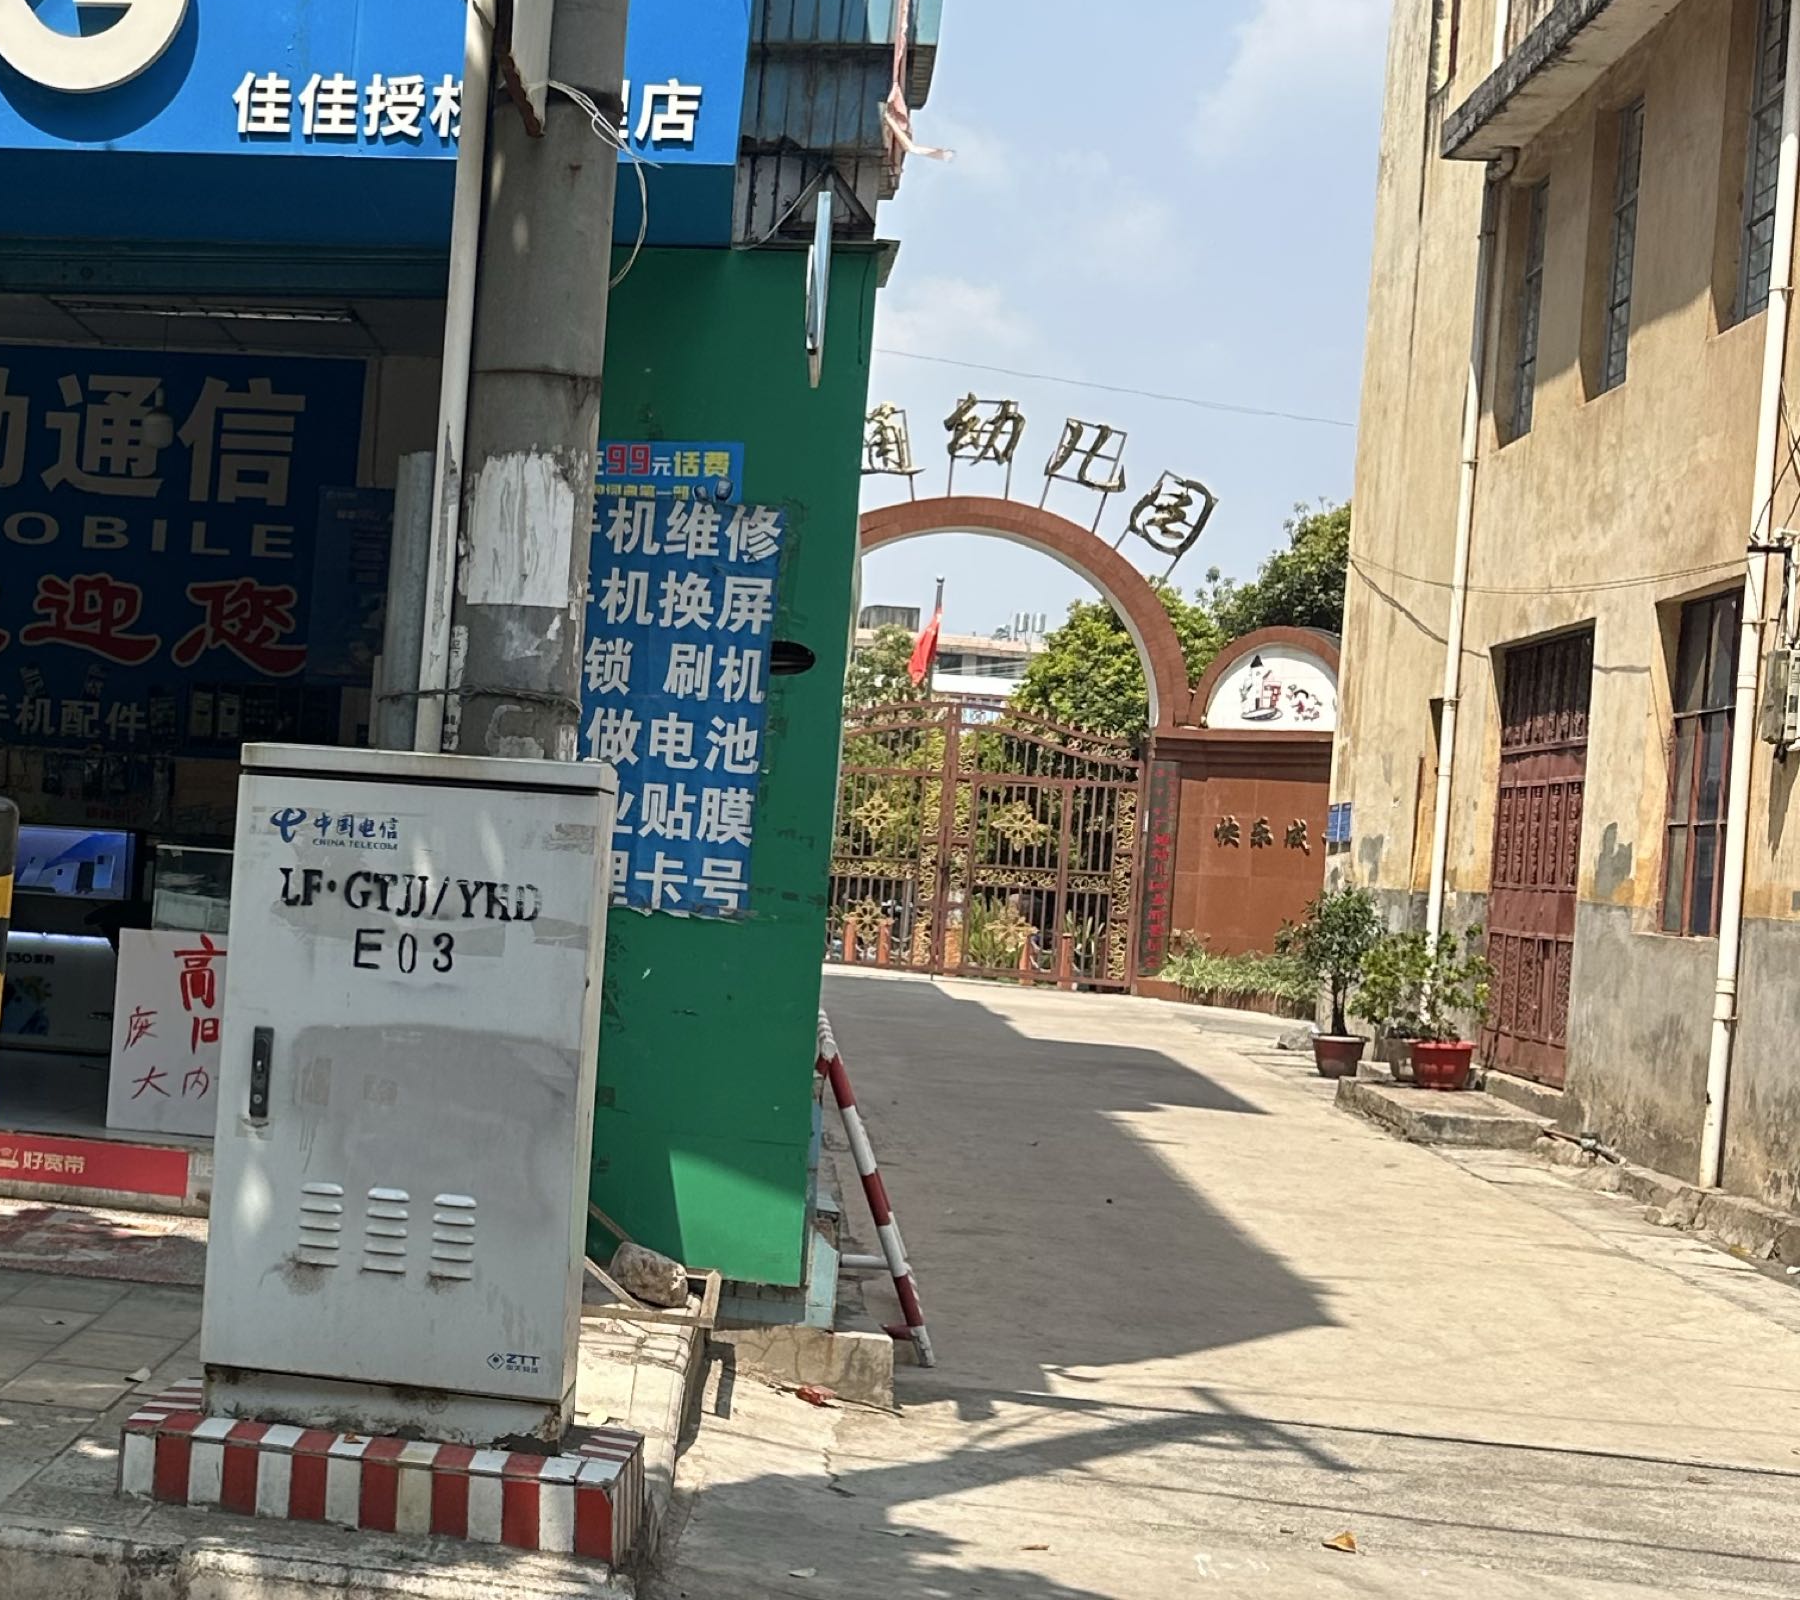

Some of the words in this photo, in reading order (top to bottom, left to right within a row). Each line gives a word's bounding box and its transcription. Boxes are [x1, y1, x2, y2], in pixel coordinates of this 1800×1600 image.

[232, 71, 702, 142] 佳佳授权店
[584, 567, 773, 635] 机换屏
[584, 637, 634, 696] 锁
[663, 643, 766, 704] 刷机
[586, 706, 760, 775] 做电池
[312, 837, 346, 848] CHINA
[349, 840, 399, 851] TELECOM
[313, 811, 399, 841] 中国电信
[1213, 815, 1326, 860] 快乐成
[22, 1150, 85, 1174] 好宽带
[506, 1352, 541, 1366] ZTT
